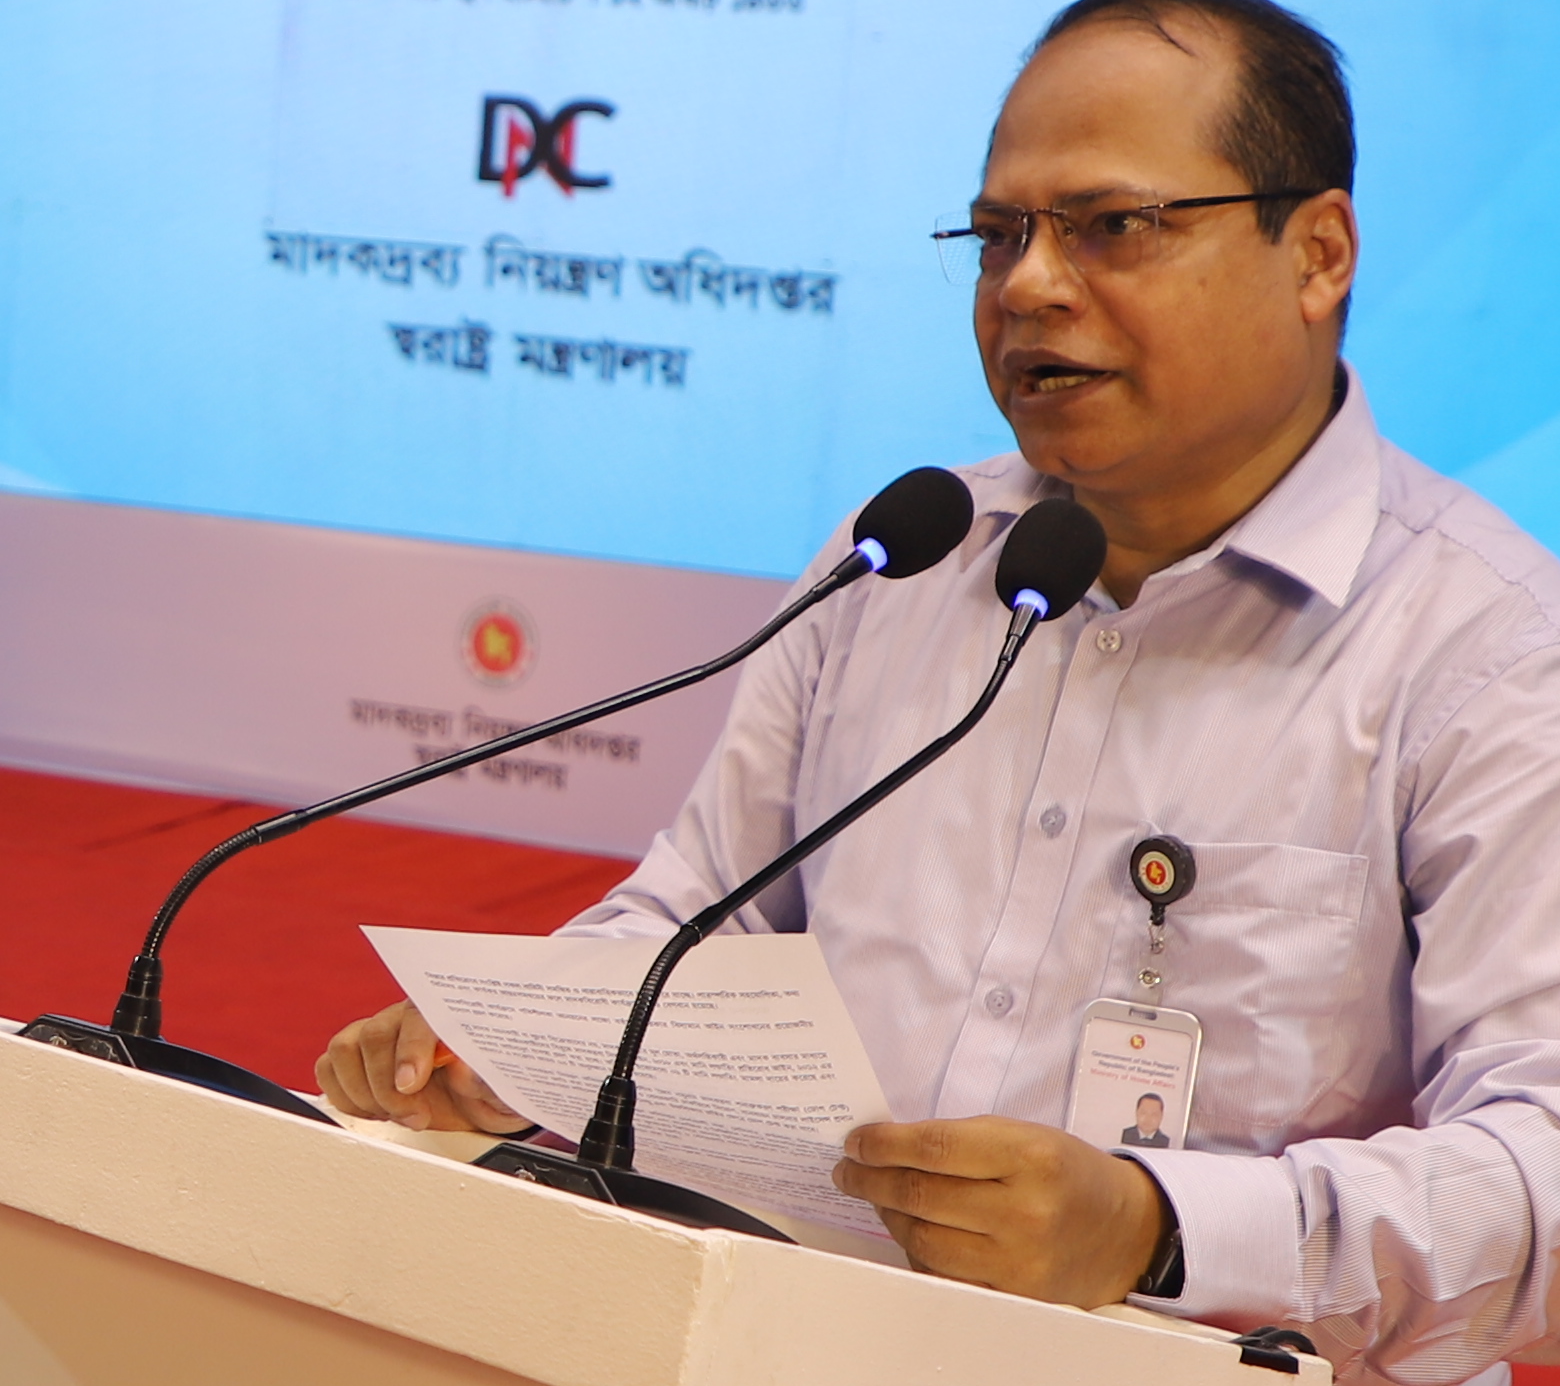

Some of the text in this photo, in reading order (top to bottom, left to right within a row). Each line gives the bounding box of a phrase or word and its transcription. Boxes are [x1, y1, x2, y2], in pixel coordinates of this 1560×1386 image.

[264, 228, 841, 315] মাদকদ্রব্য নিয়ন্ত্রণ অধিদপ্তর
[387, 316, 692, 389] স্বরাষ্ট্র মন্ত্রণালয়
